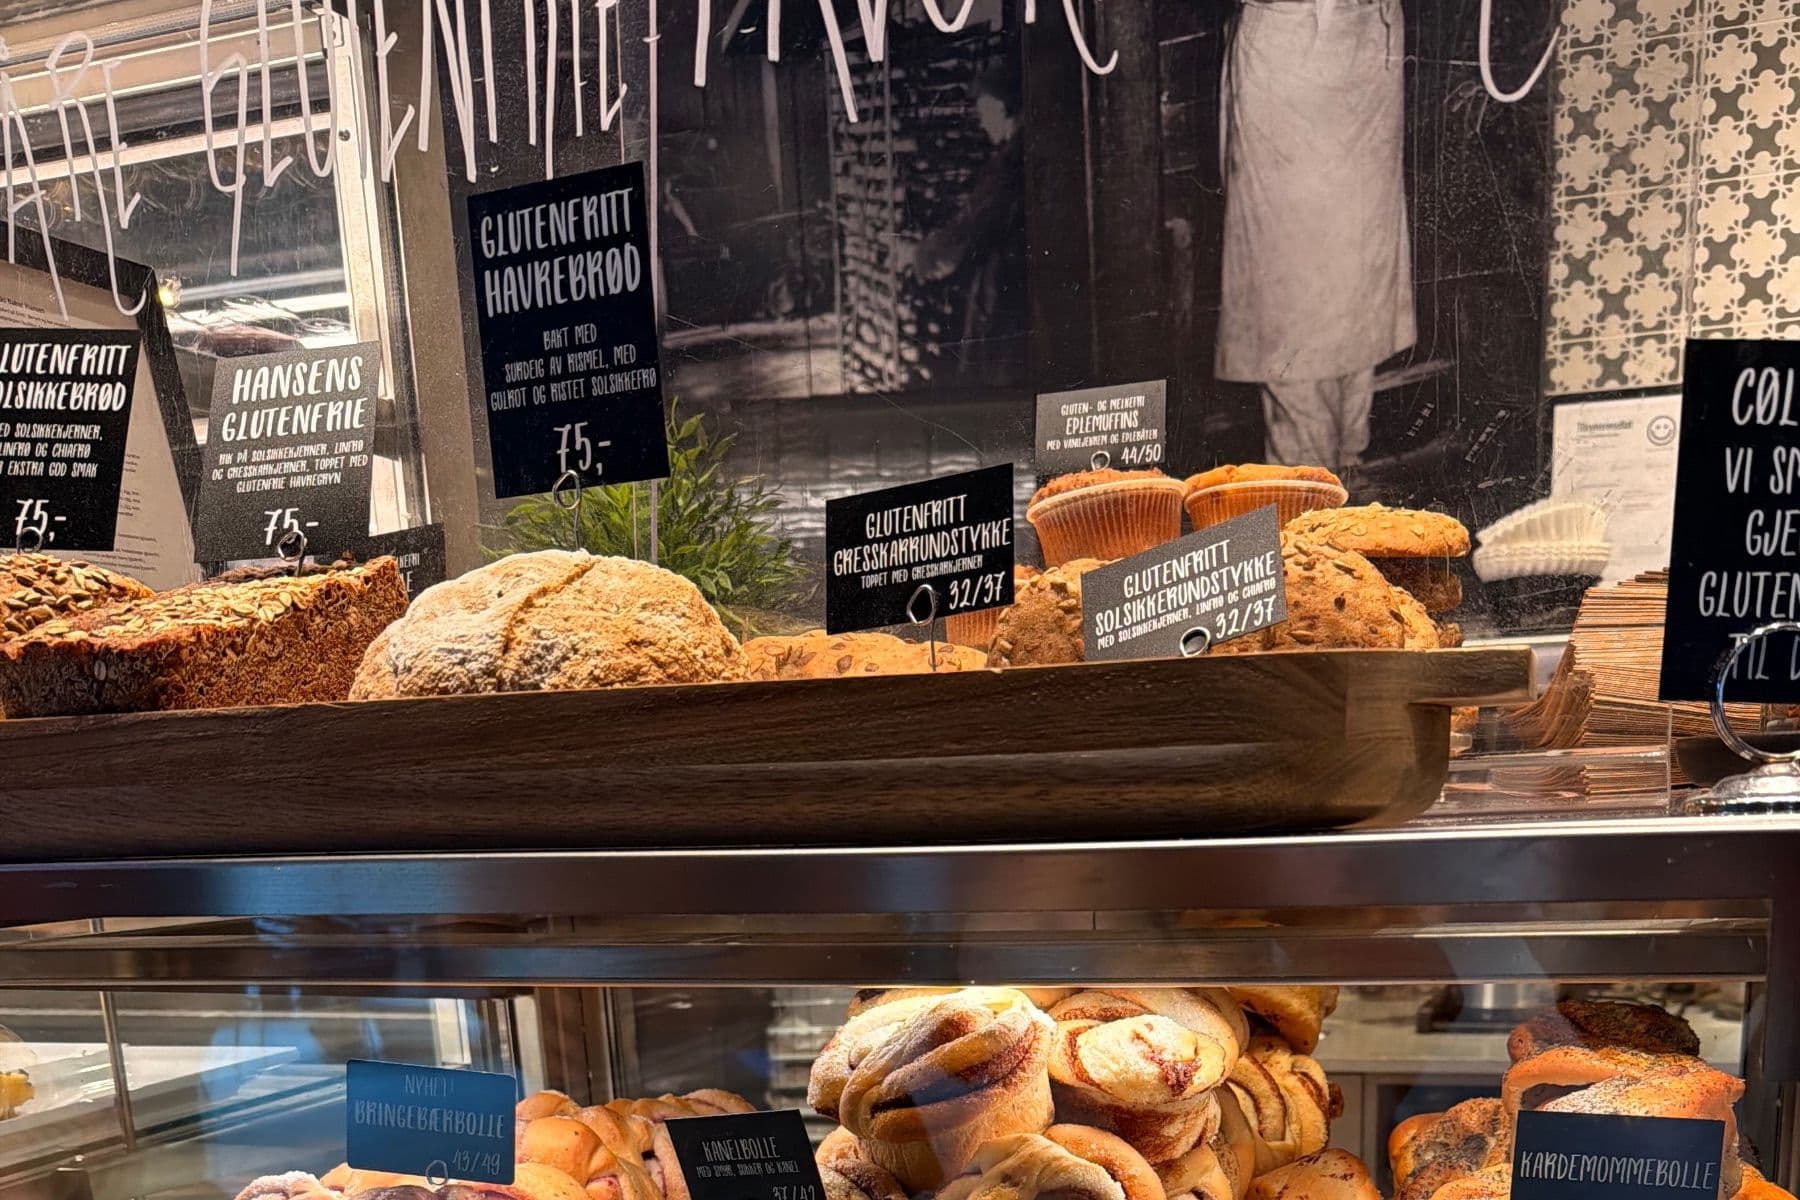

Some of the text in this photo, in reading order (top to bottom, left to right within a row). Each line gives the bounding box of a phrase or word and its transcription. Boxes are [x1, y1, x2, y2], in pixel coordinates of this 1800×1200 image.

[480, 186, 633, 259] GLUTENFRITT
[484, 242, 641, 318] HAVREBRØD
[543, 323, 597, 350] BAKT MED
[232, 356, 363, 404] HANSENS
[504, 359, 545, 383] SURDEIG
[550, 357, 562, 376] AV
[614, 344, 636, 365] MED
[0, 380, 126, 412] LSIKKEBRØD
[490, 367, 657, 411] GULROT OG RISTET SOLSIKKEFRØ
[1097, 399, 1106, 412] OG
[1110, 396, 1145, 411] MELKEFRI
[222, 398, 368, 441] GLUTENFRIE
[1065, 410, 1139, 435] EPLEMUFFINS
[35, 442, 48, 457] OG
[52, 442, 91, 458] CHIAFRØ
[237, 449, 248, 463] PÅ
[334, 440, 364, 454] LINFRØ
[1046, 439, 1061, 451] MED
[1110, 433, 1119, 445] OG
[1120, 443, 1161, 464] 44/50
[8, 460, 44, 476] EKSTRA
[49, 461, 67, 477] GOD
[71, 462, 98, 478] SMAK
[211, 468, 223, 481] OG
[315, 456, 345, 470] TOPPET
[349, 454, 369, 468] MED
[236, 472, 341, 494] GLUTENFRIE HAVREGRYN
[1725, 447, 1753, 494] VI
[866, 494, 968, 539] GLUTENFRITT
[833, 518, 1012, 577] GRESSKARRUNDSTYKKE
[861, 571, 888, 590] TOPPET
[891, 568, 909, 584] MED
[1123, 539, 1231, 598] GLUTENFRITT
[949, 570, 1007, 610] 32/37
[1095, 550, 1276, 636] SOLSIKKERUNDSTYKKE
[1097, 636, 1115, 650] MED
[1196, 596, 1224, 616] LINFRØ
[1227, 590, 1239, 605] OG
[1242, 577, 1277, 599] CHIAFRØ
[1215, 594, 1277, 639] 32/37
[354, 1100, 505, 1139] BRINGEBÆRBOLLE
[701, 1136, 781, 1163] KANELBOLLE
[695, 1165, 712, 1178] MED
[1520, 1150, 1717, 1190] KARDEMOMMEBOLLE
